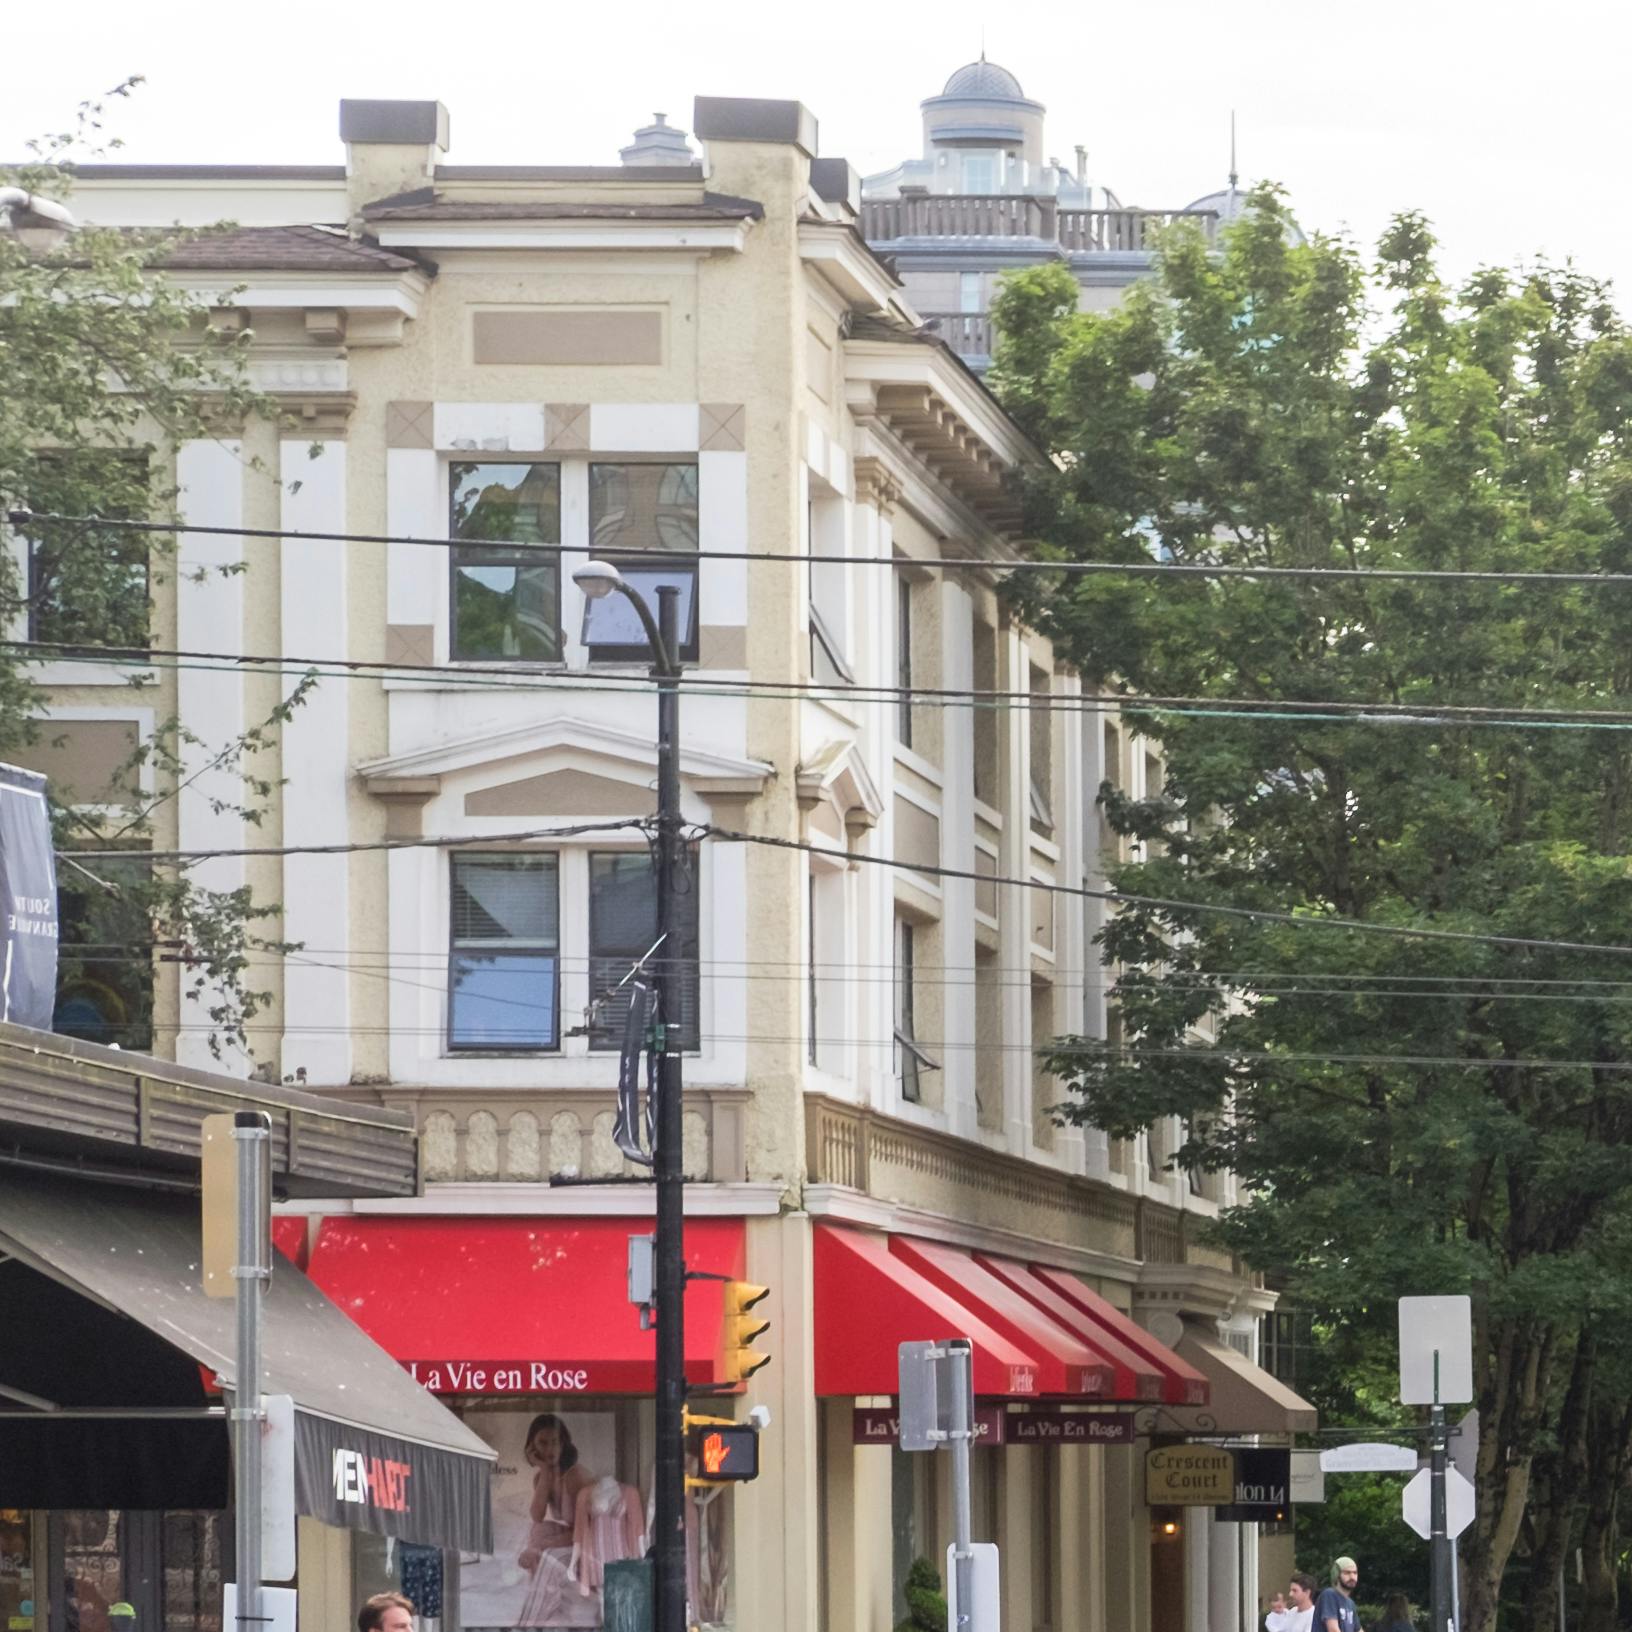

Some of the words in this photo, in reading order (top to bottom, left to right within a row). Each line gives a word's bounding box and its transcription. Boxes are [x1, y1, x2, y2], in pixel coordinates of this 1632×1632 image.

[410, 1362, 441, 1390] La
[446, 1362, 486, 1390] Vie
[493, 1371, 522, 1390] en
[530, 1362, 588, 1390] Rose
[865, 1420, 888, 1435] La
[1017, 1421, 1037, 1436] La
[1038, 1421, 1060, 1436] Vie
[1063, 1421, 1085, 1436] En
[1089, 1421, 1122, 1436] Rose
[1150, 1452, 1228, 1470] Crescent
[1165, 1471, 1218, 1489] Court
